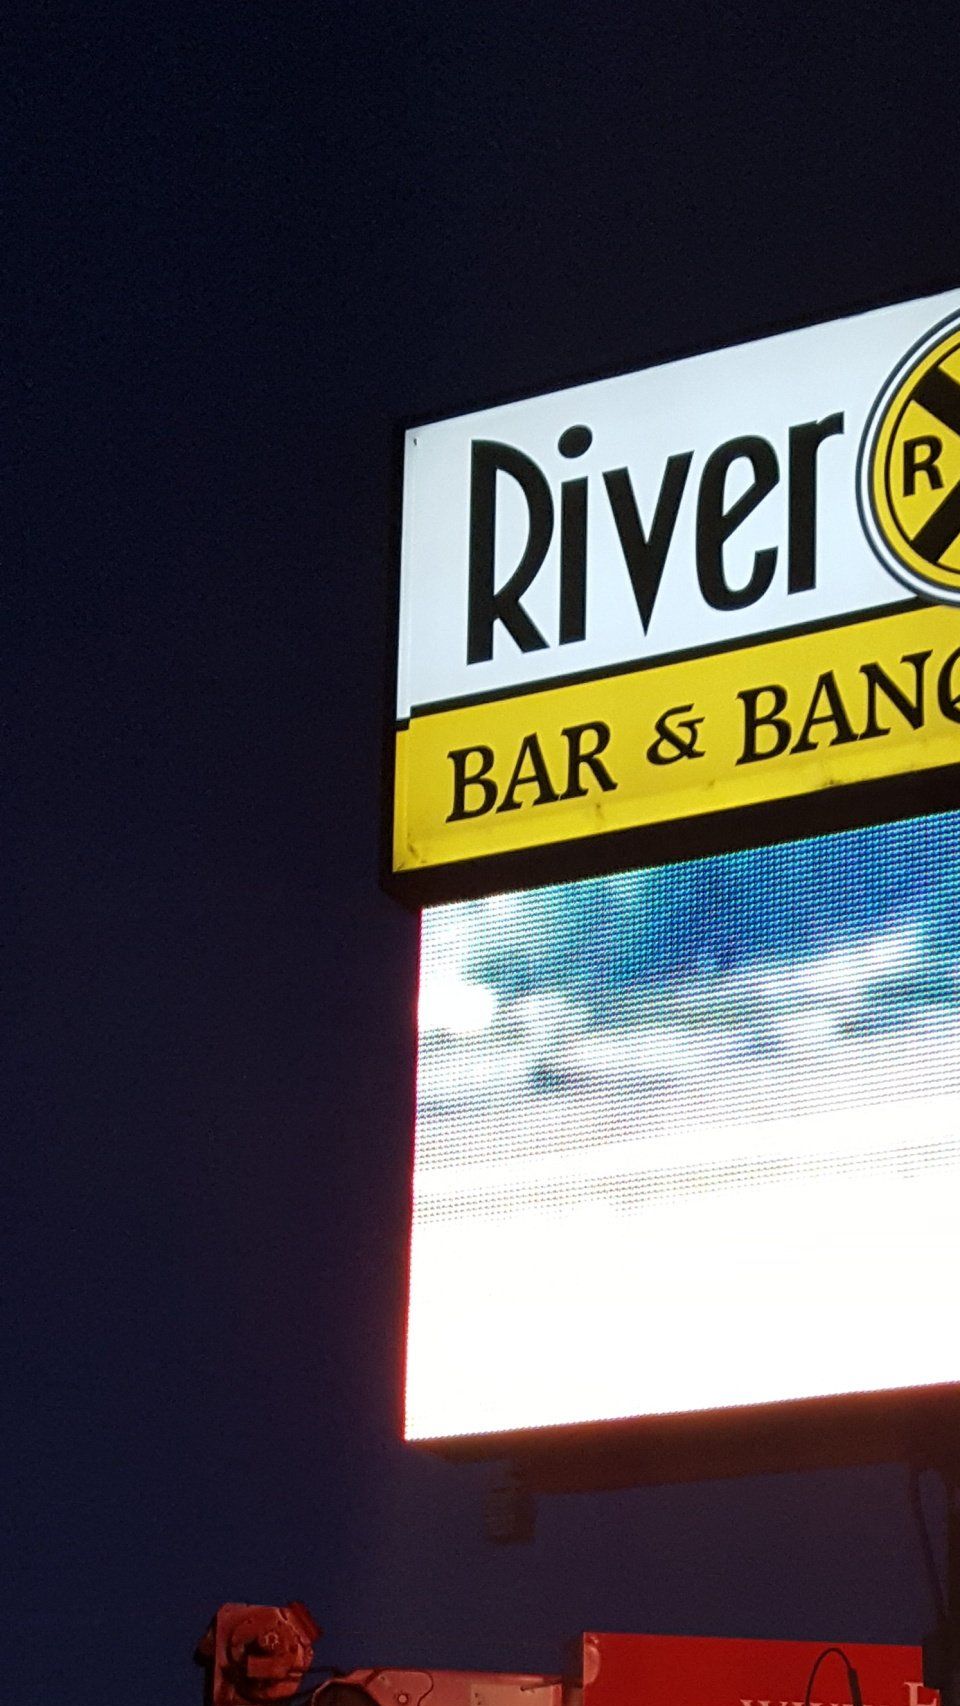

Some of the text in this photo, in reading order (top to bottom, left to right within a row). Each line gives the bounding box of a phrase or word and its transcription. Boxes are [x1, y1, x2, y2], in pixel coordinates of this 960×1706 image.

[903, 435, 945, 498] R
[466, 412, 845, 666] River
[445, 721, 619, 823] BAR
[646, 704, 706, 767] &
